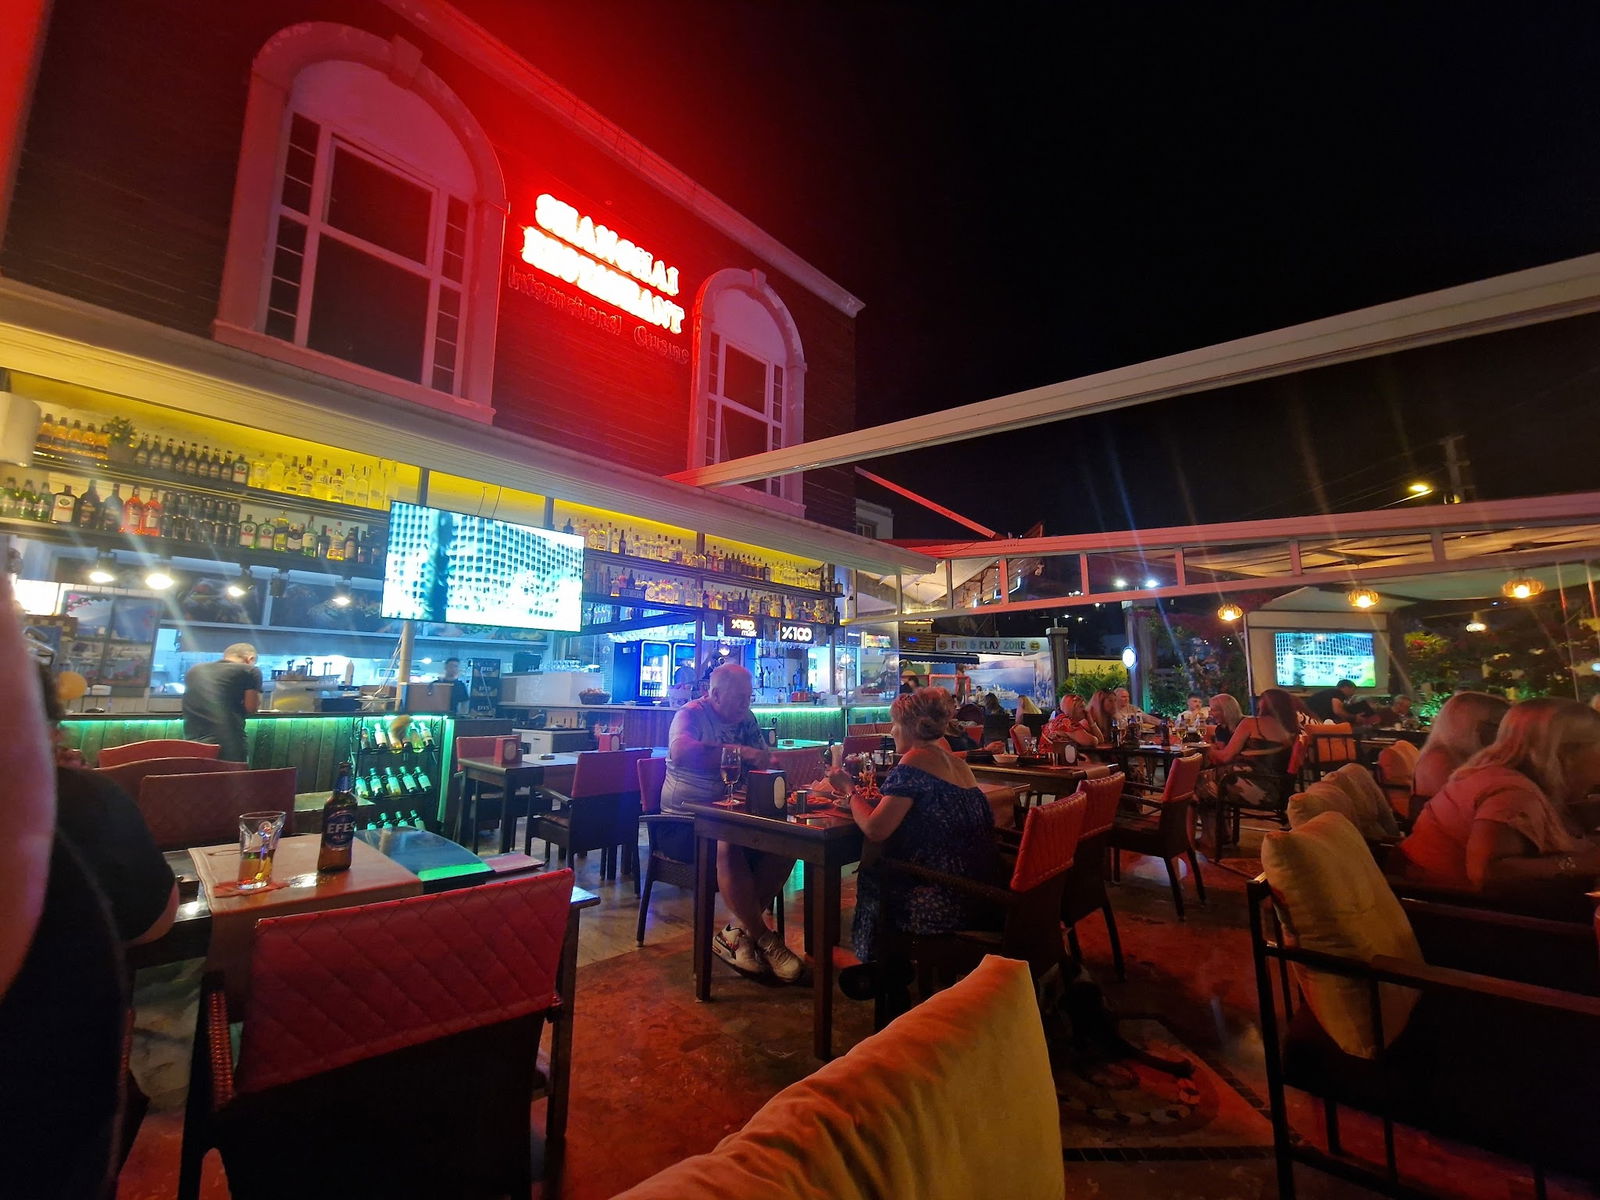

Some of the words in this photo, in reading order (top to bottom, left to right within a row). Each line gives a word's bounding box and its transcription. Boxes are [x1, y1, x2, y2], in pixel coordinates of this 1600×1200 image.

[781, 626, 812, 641] %100
[951, 641, 968, 650] FUN
[979, 641, 1000, 650] PLAY
[1003, 641, 1026, 650] ZONE
